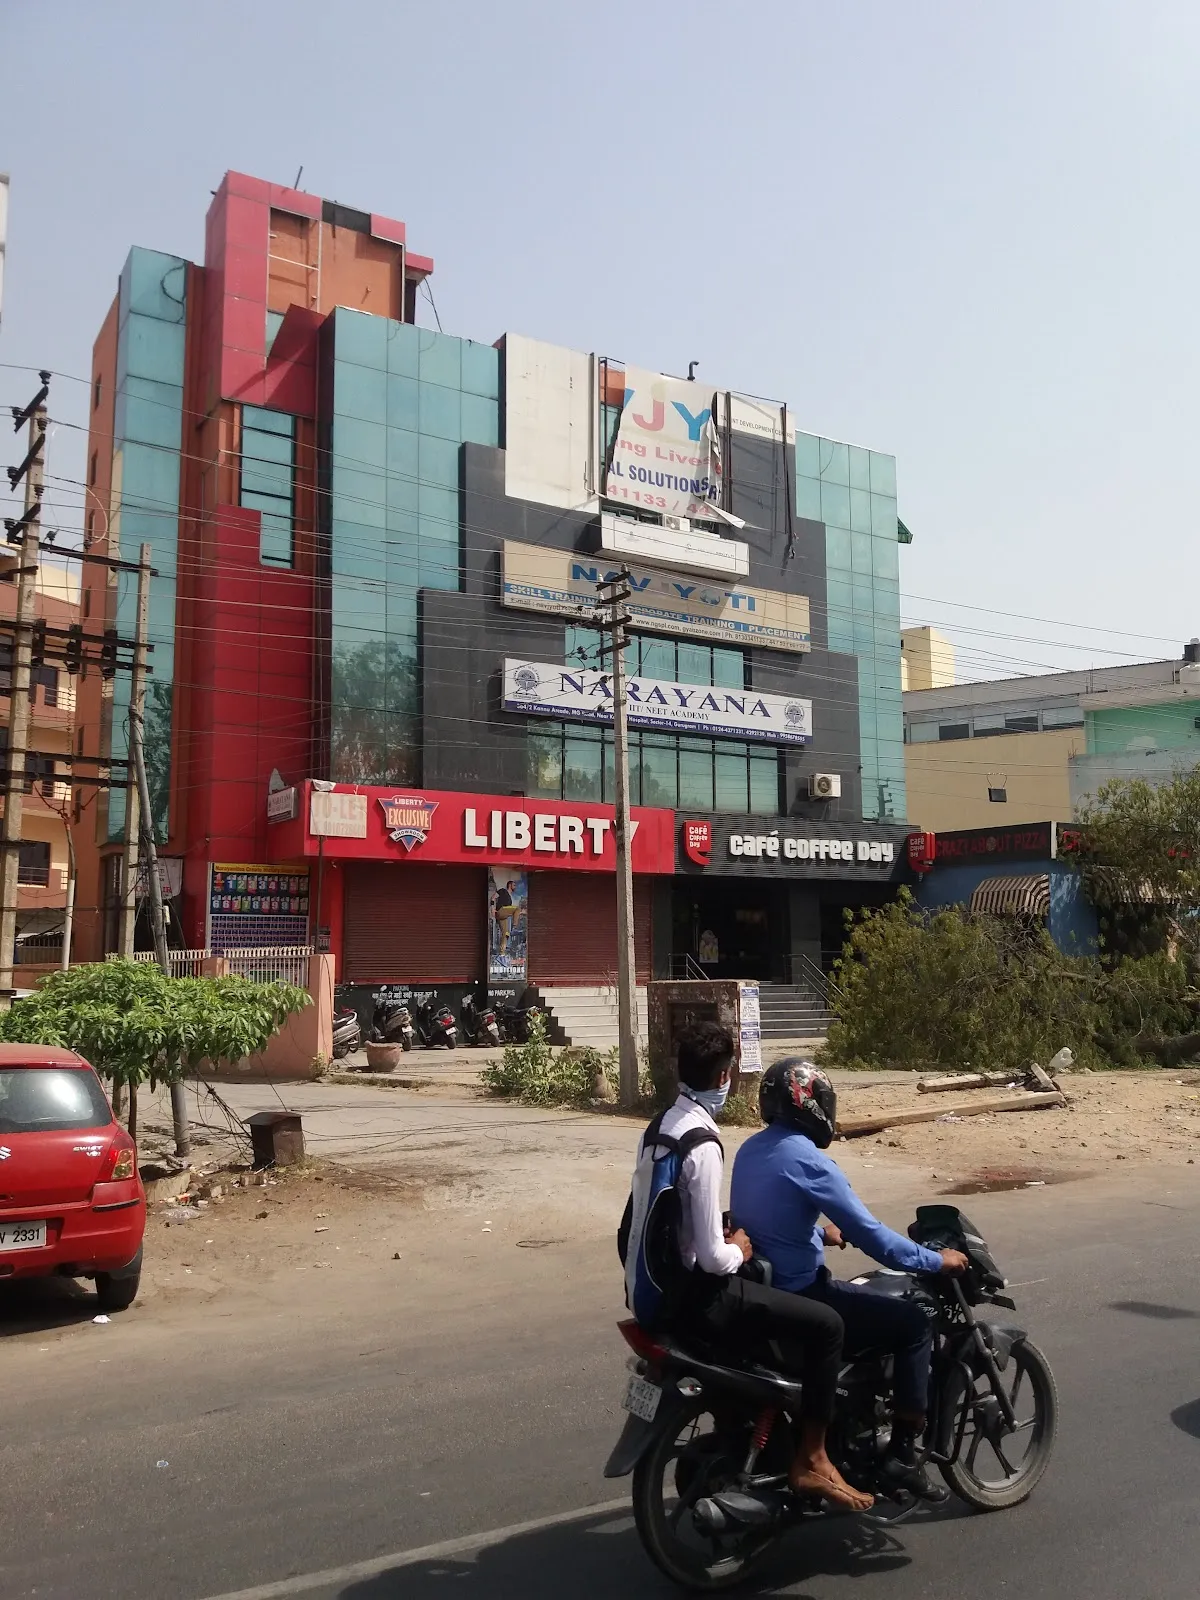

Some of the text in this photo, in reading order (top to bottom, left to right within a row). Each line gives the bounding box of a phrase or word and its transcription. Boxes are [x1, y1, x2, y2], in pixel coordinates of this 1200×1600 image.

[628, 464, 709, 494] SOLUTIONS
[510, 584, 545, 598] SKILL
[624, 602, 684, 620] ORPORATE
[685, 615, 735, 630] TRAINING
[748, 625, 807, 640] PLACEMENT
[558, 672, 772, 718] NARAYANA
[646, 706, 668, 716] NEET
[670, 710, 711, 720] ACADEMY
[394, 797, 424, 806] LIBERTY
[388, 807, 430, 828] EXCLUSIVE
[393, 829, 424, 840] SHOWROOM
[1014, 831, 1047, 850] PIZZA
[487, 989, 516, 997] NO PARKING
[12, 1228, 40, 1243] 2331
